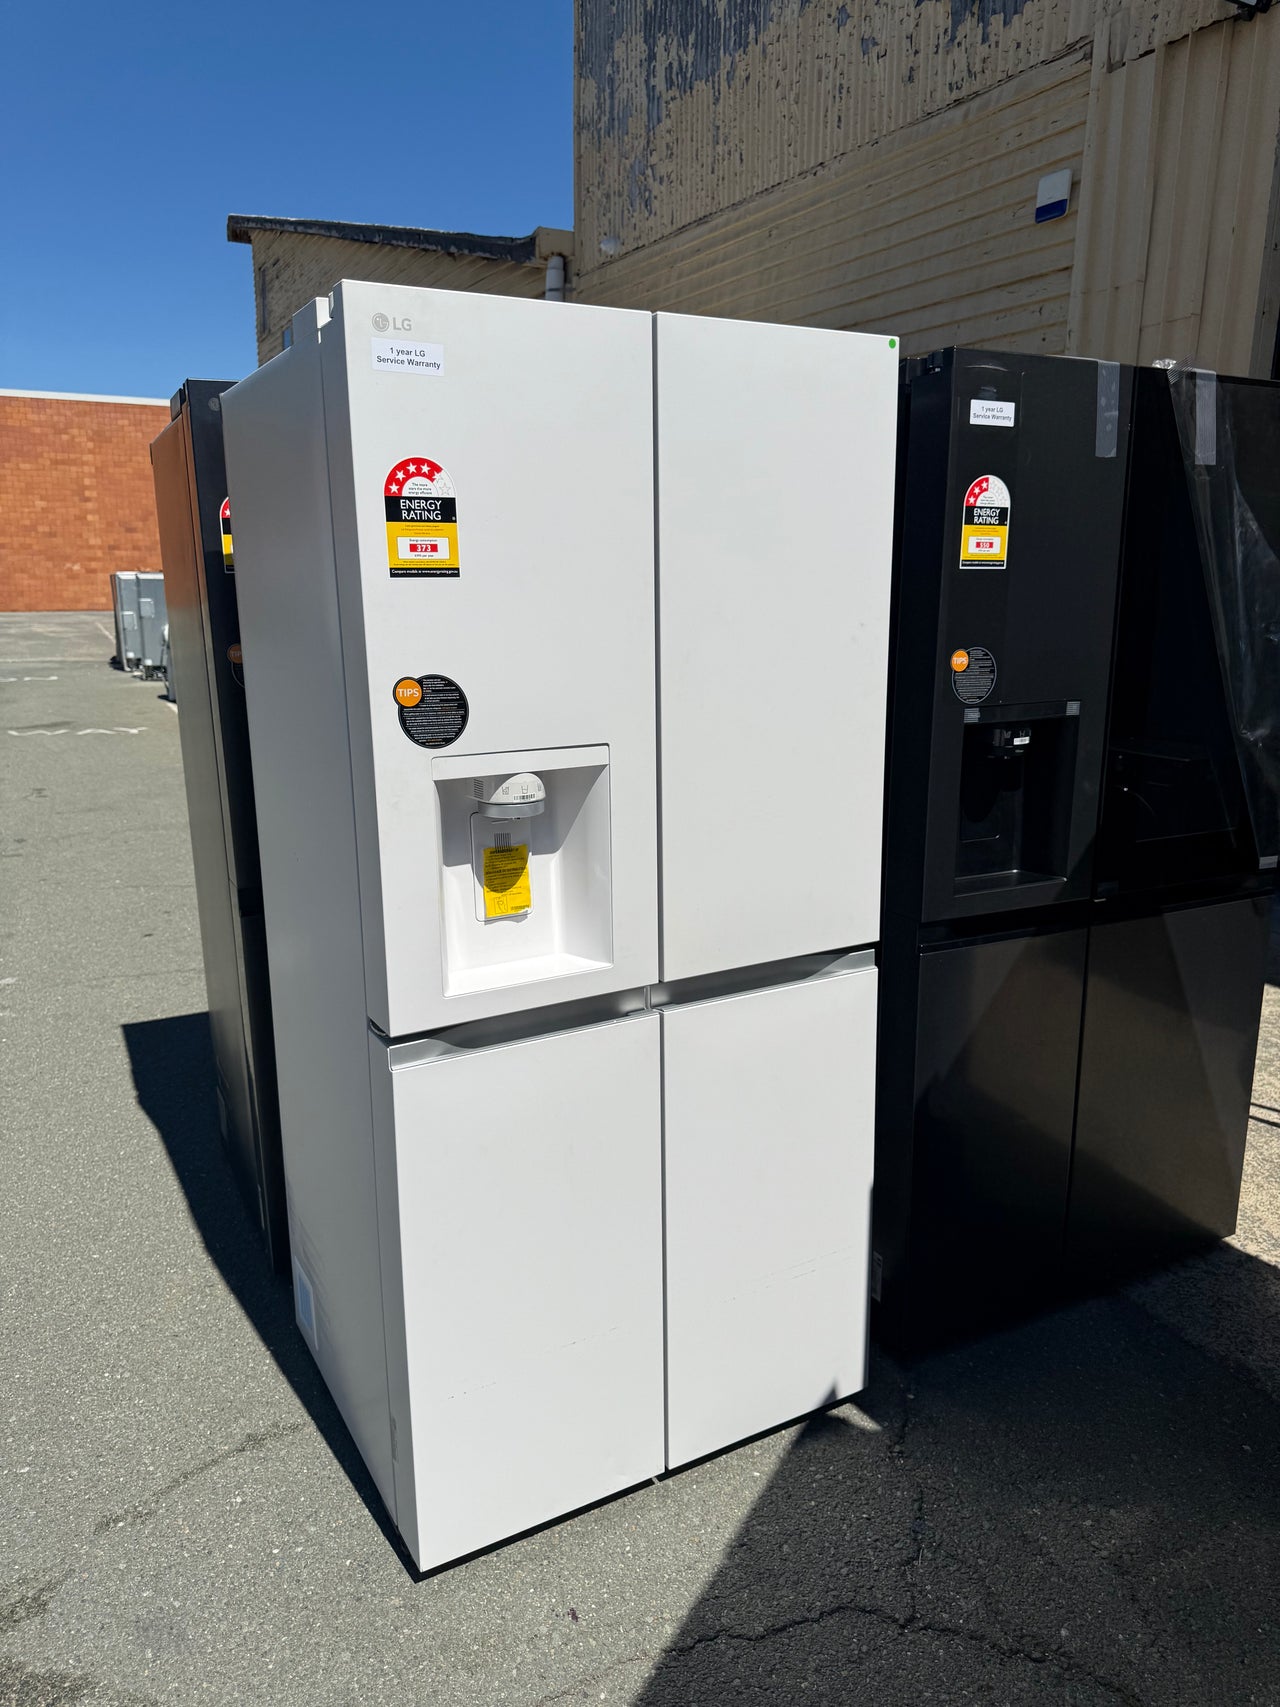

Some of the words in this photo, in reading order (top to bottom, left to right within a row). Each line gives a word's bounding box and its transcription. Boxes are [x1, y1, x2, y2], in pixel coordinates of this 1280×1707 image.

[392, 317, 412, 332] LG
[396, 348, 412, 356] year
[414, 349, 426, 358] LG
[376, 355, 406, 365] Service
[406, 358, 441, 370] Warranty
[400, 500, 442, 510] ENERGY
[402, 510, 442, 520] RATING
[974, 508, 1000, 516] ENERGY
[974, 516, 999, 524] RATING
[398, 688, 420, 697] TIPS
